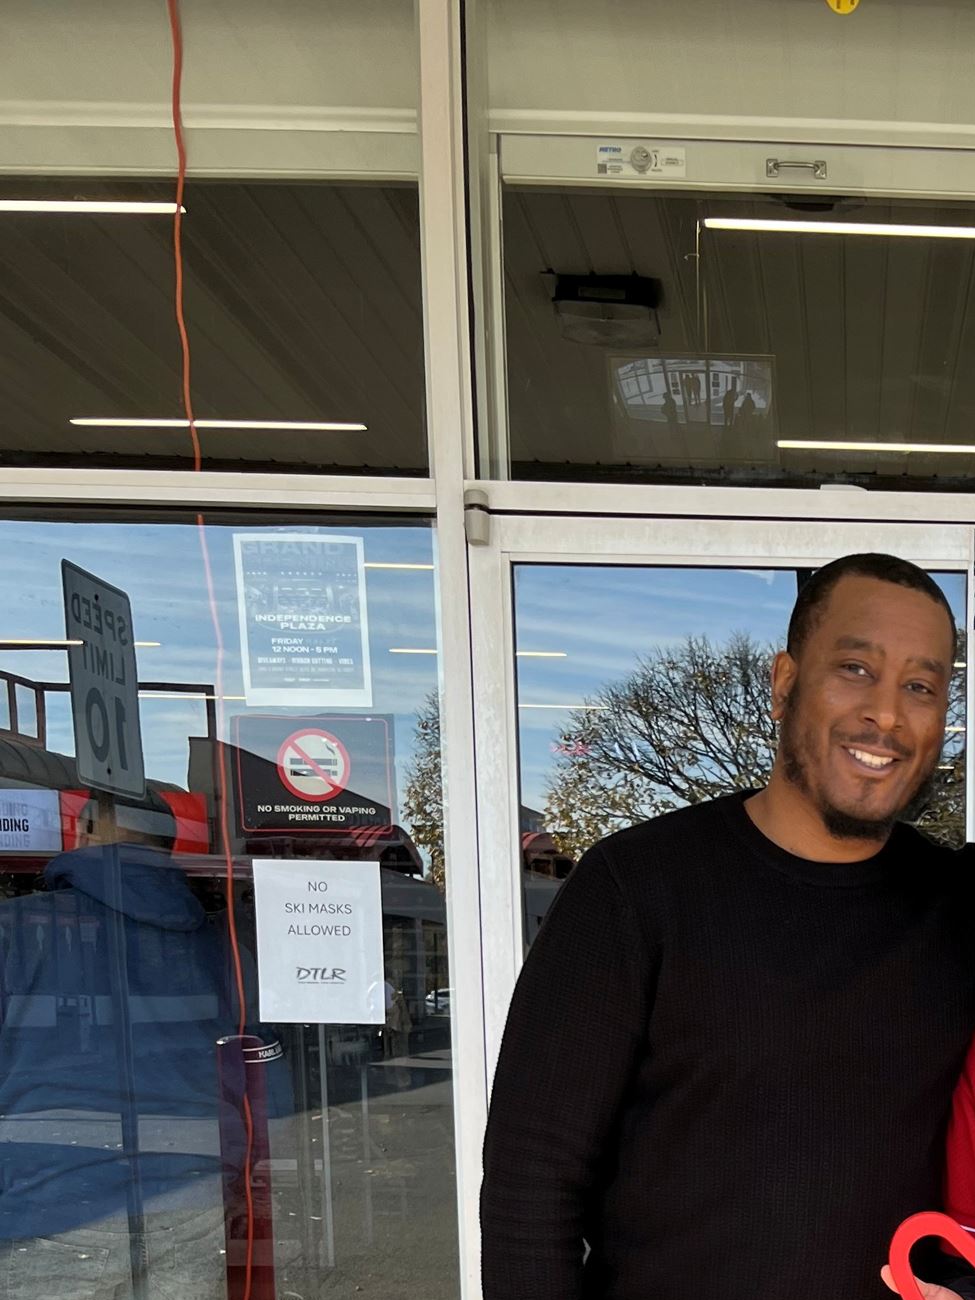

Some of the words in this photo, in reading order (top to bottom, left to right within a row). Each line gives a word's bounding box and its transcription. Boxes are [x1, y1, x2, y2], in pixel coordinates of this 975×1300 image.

[255, 614, 352, 623] INDEPENDENCE
[280, 622, 326, 630] PLAZA
[271, 637, 304, 646] FRIDAY
[272, 645, 282, 654] 12
[283, 645, 311, 654] NOON
[316, 646, 322, 654] 5
[323, 646, 338, 654] PM
[257, 805, 272, 813] NO
[274, 805, 320, 813] SMOKING
[322, 806, 337, 814] OR
[338, 807, 376, 816] VAPING
[288, 813, 346, 822] PERMITTED
[0, 818, 30, 832] DING
[308, 881, 328, 893] NO
[285, 902, 305, 914] SKI
[308, 903, 352, 915] MASKS
[288, 924, 352, 937] ALLOWED
[296, 966, 347, 982] DTLR
